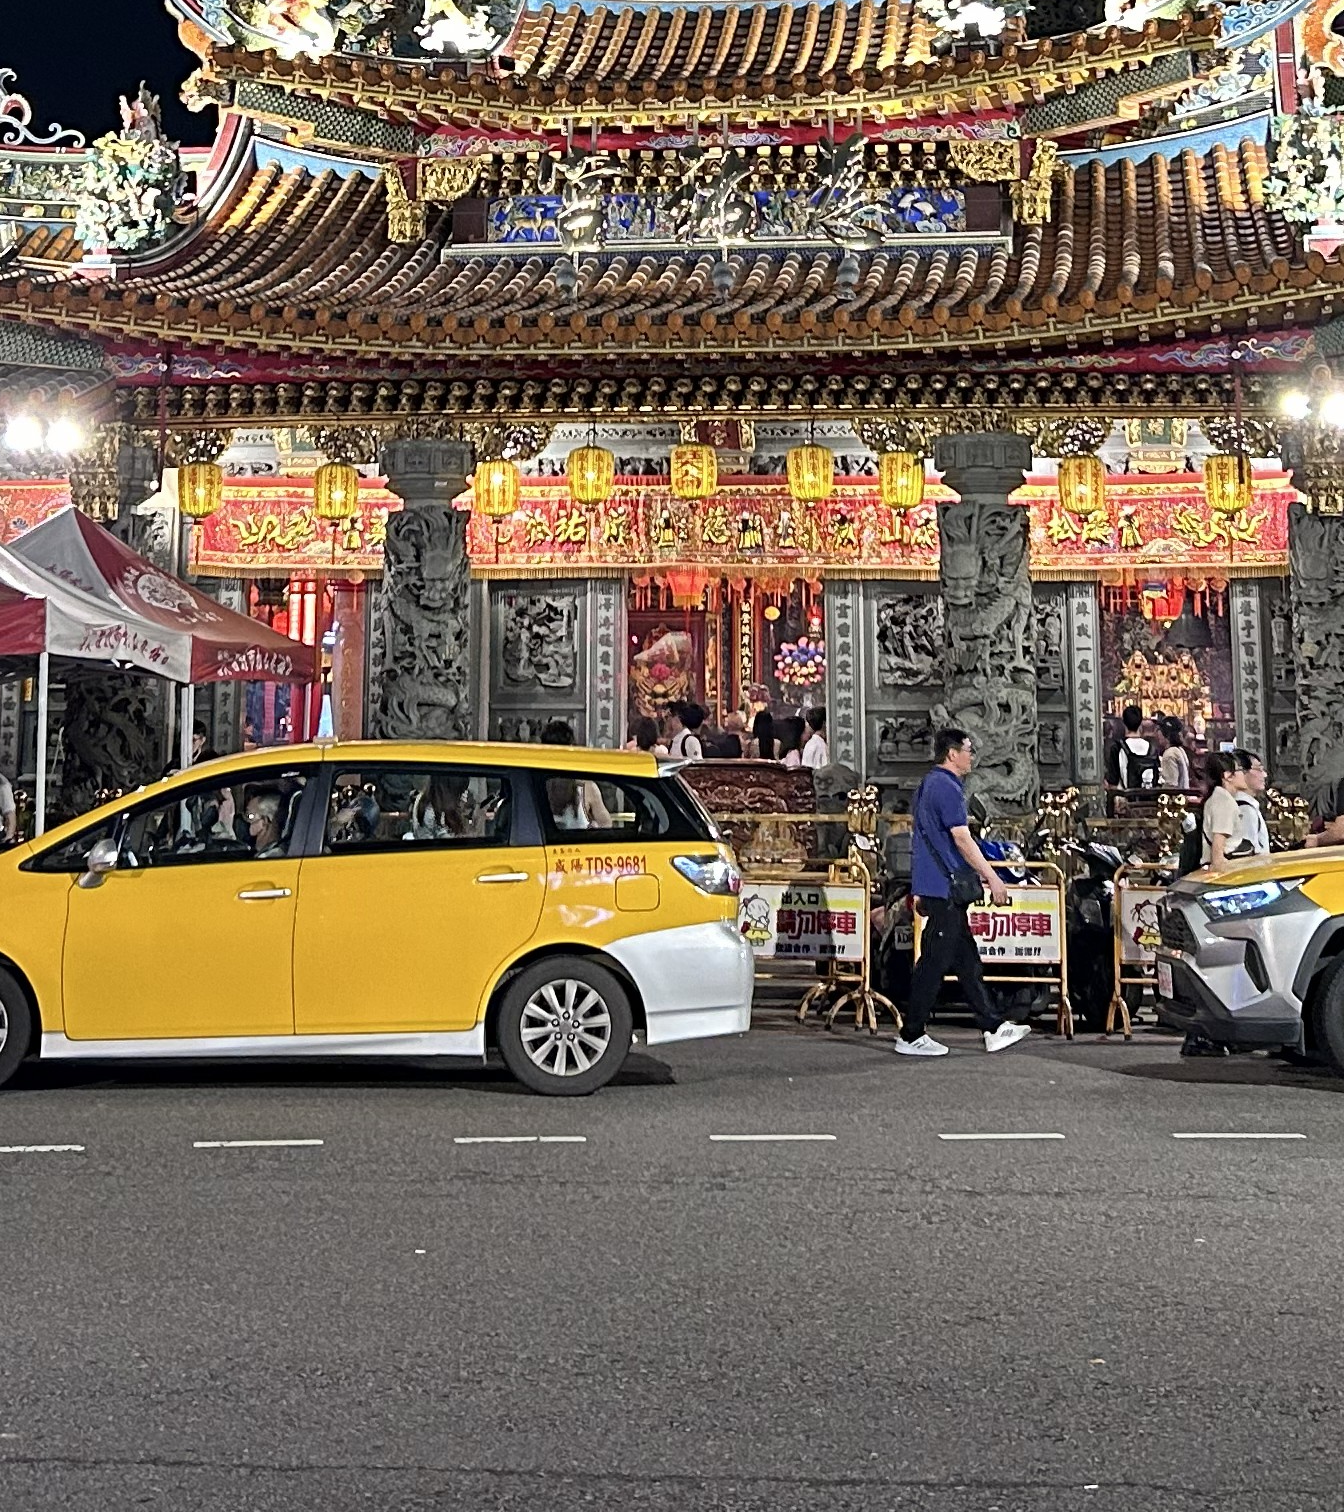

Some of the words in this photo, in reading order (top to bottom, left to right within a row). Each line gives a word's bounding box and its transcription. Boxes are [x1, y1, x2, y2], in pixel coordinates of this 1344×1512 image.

[585, 855, 647, 875] TDS-9681
[781, 891, 819, 906] 出入口
[776, 909, 857, 939] 請勿停車
[969, 912, 1052, 942] 請勿停車
